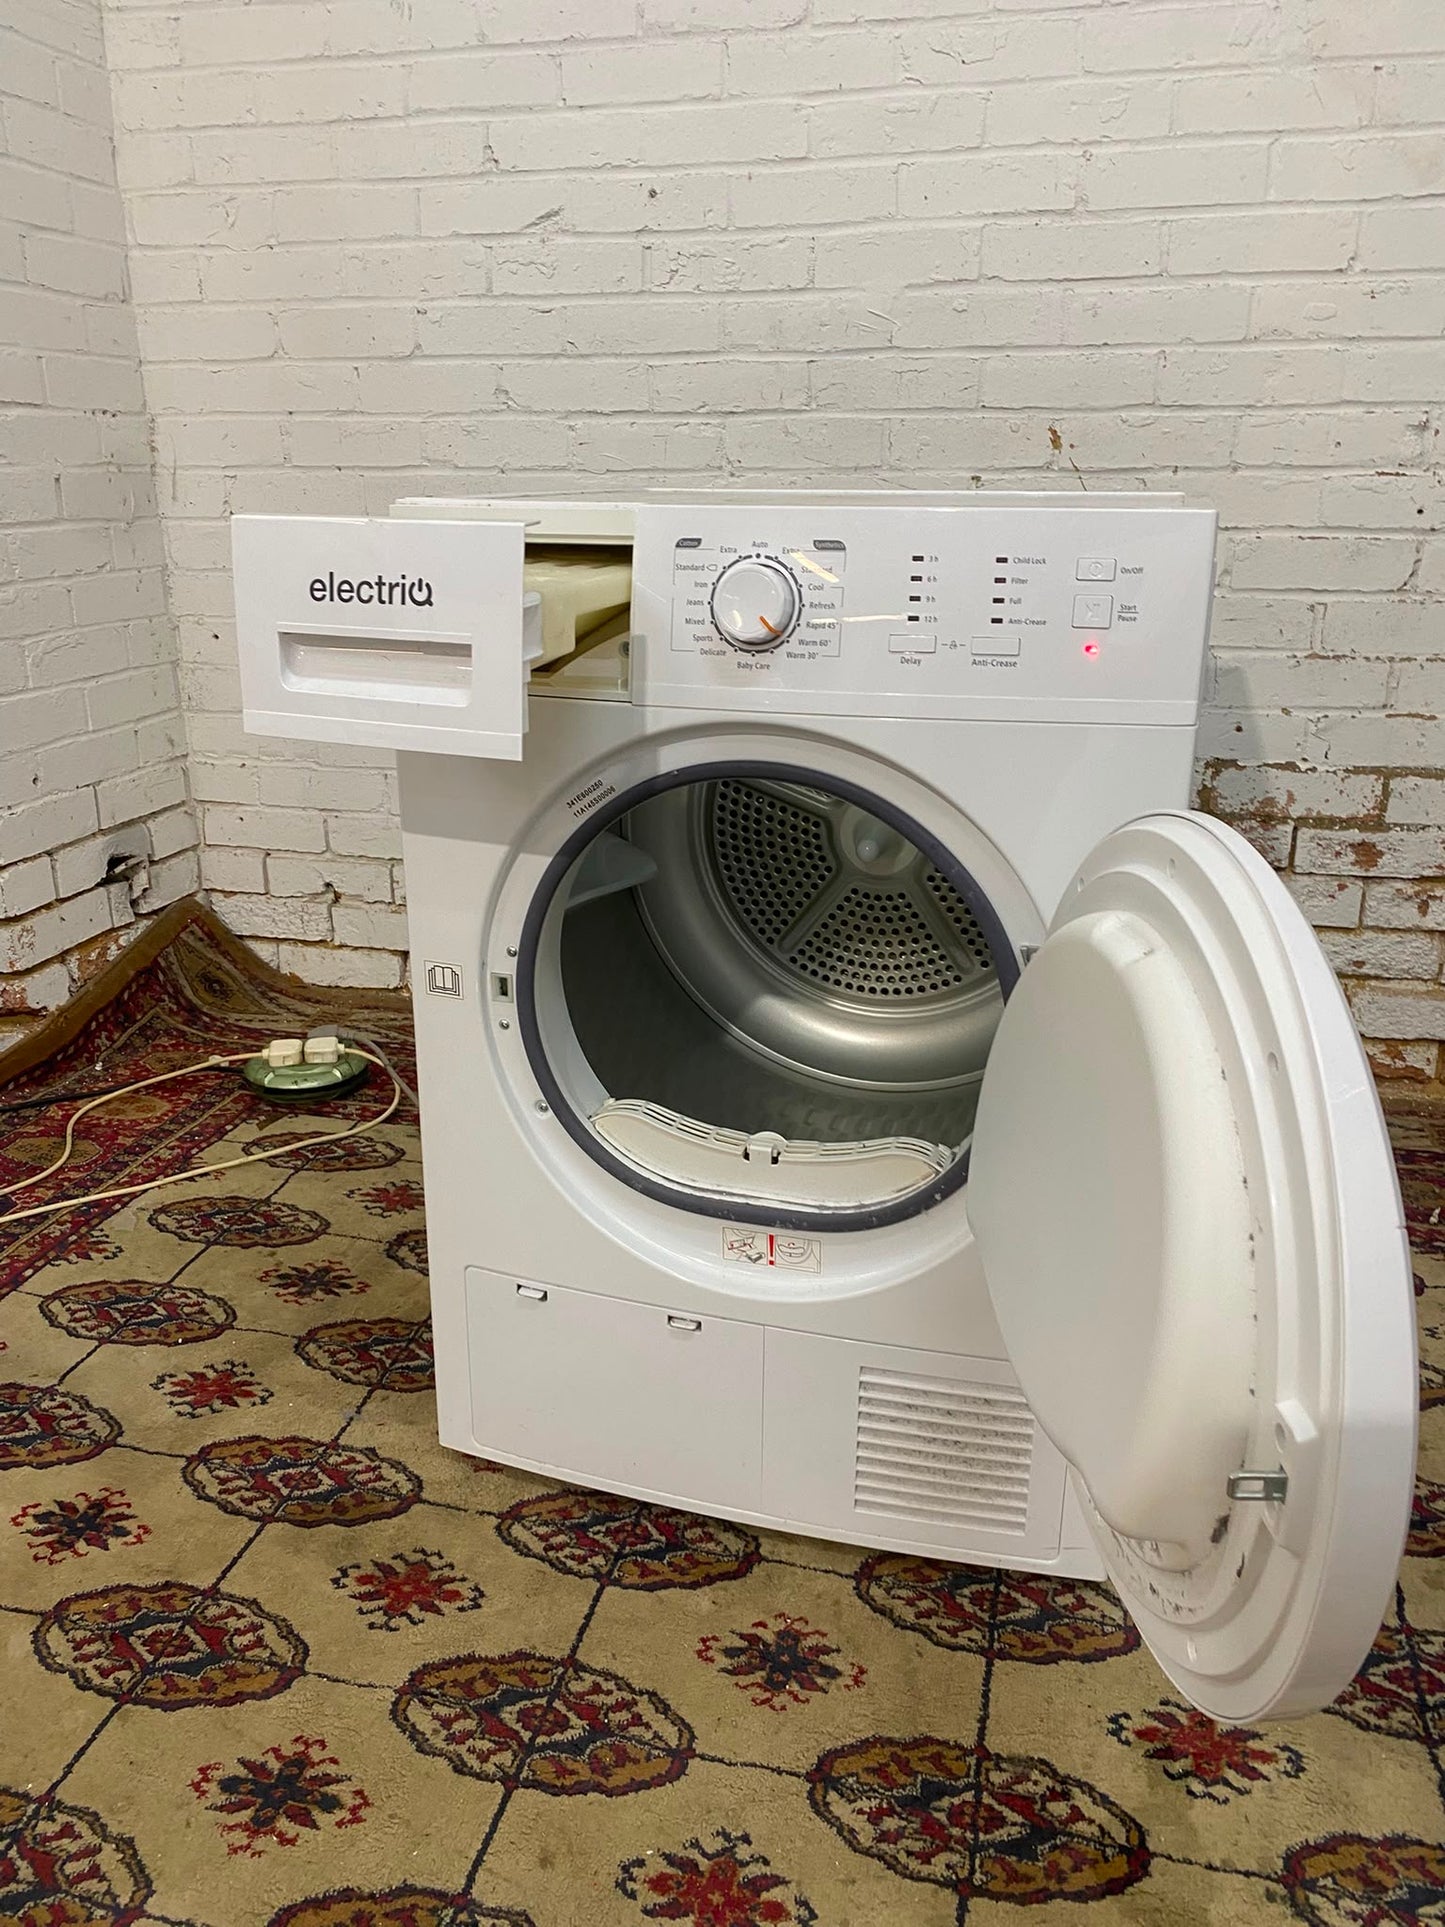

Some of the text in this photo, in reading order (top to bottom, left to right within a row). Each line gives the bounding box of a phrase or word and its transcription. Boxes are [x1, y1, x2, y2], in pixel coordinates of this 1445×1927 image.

[720, 546, 738, 554] Extra
[1013, 557, 1032, 565] Child
[1120, 567, 1143, 575] On/Off
[809, 602, 836, 610] Refresh
[1120, 604, 1137, 612] Start
[685, 618, 706, 626] Mixed
[1008, 618, 1047, 626] Anti-Crease
[1118, 615, 1138, 623] Pause
[693, 634, 714, 643] Sports
[798, 640, 818, 648] Warm
[700, 648, 728, 657] Delicate
[786, 652, 806, 660] Warm
[900, 656, 922, 666] Delay
[971, 658, 1018, 668] Anti-Crease
[737, 661, 770, 670] Baby Care
